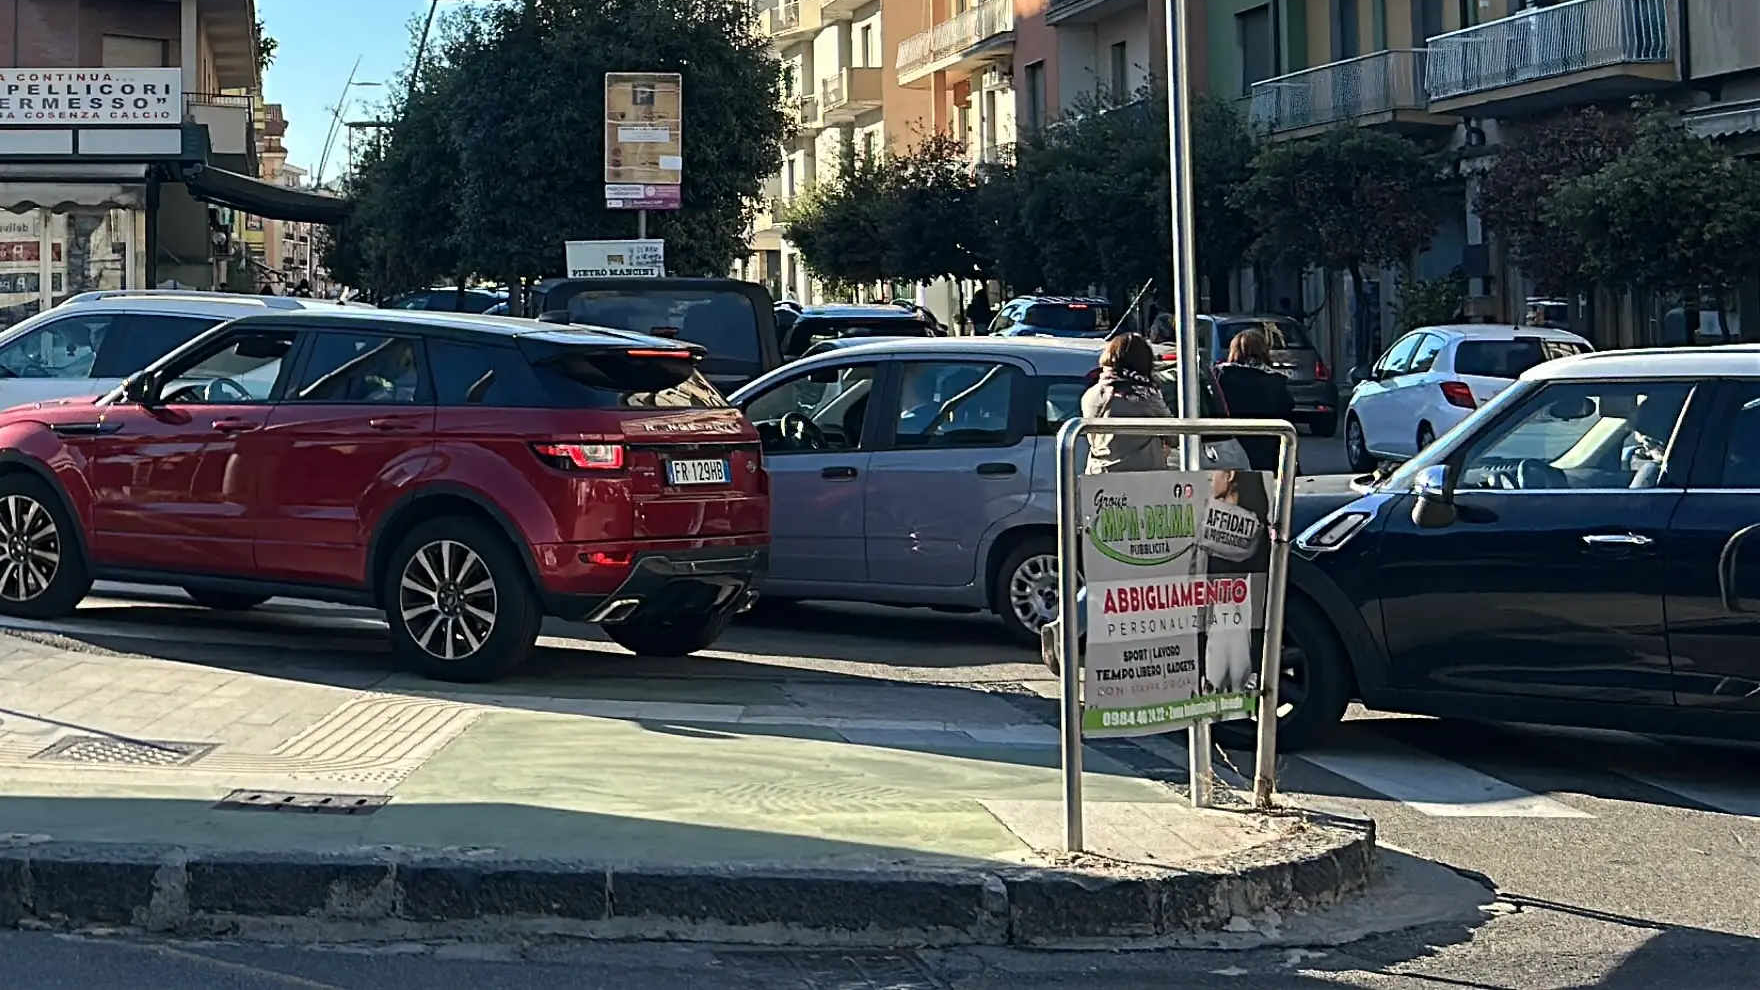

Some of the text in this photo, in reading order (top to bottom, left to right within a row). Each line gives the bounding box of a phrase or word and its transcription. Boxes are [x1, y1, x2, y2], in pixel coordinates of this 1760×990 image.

[7, 83, 171, 96] PELLICORI
[24, 111, 101, 119] COSENZA
[109, 111, 171, 119] CALCIO
[572, 269, 607, 277] PIETRO
[674, 461, 724, 481] FR 129HB
[1206, 508, 1255, 537] AFFIDATI
[1103, 579, 1248, 614] ABBIGLIAMENTO
[1123, 645, 1180, 662] SPORT LAVORO
[1096, 669, 1135, 681] TEMPO
[1166, 659, 1196, 674] GADGETS
[1102, 711, 1135, 726] 0984
